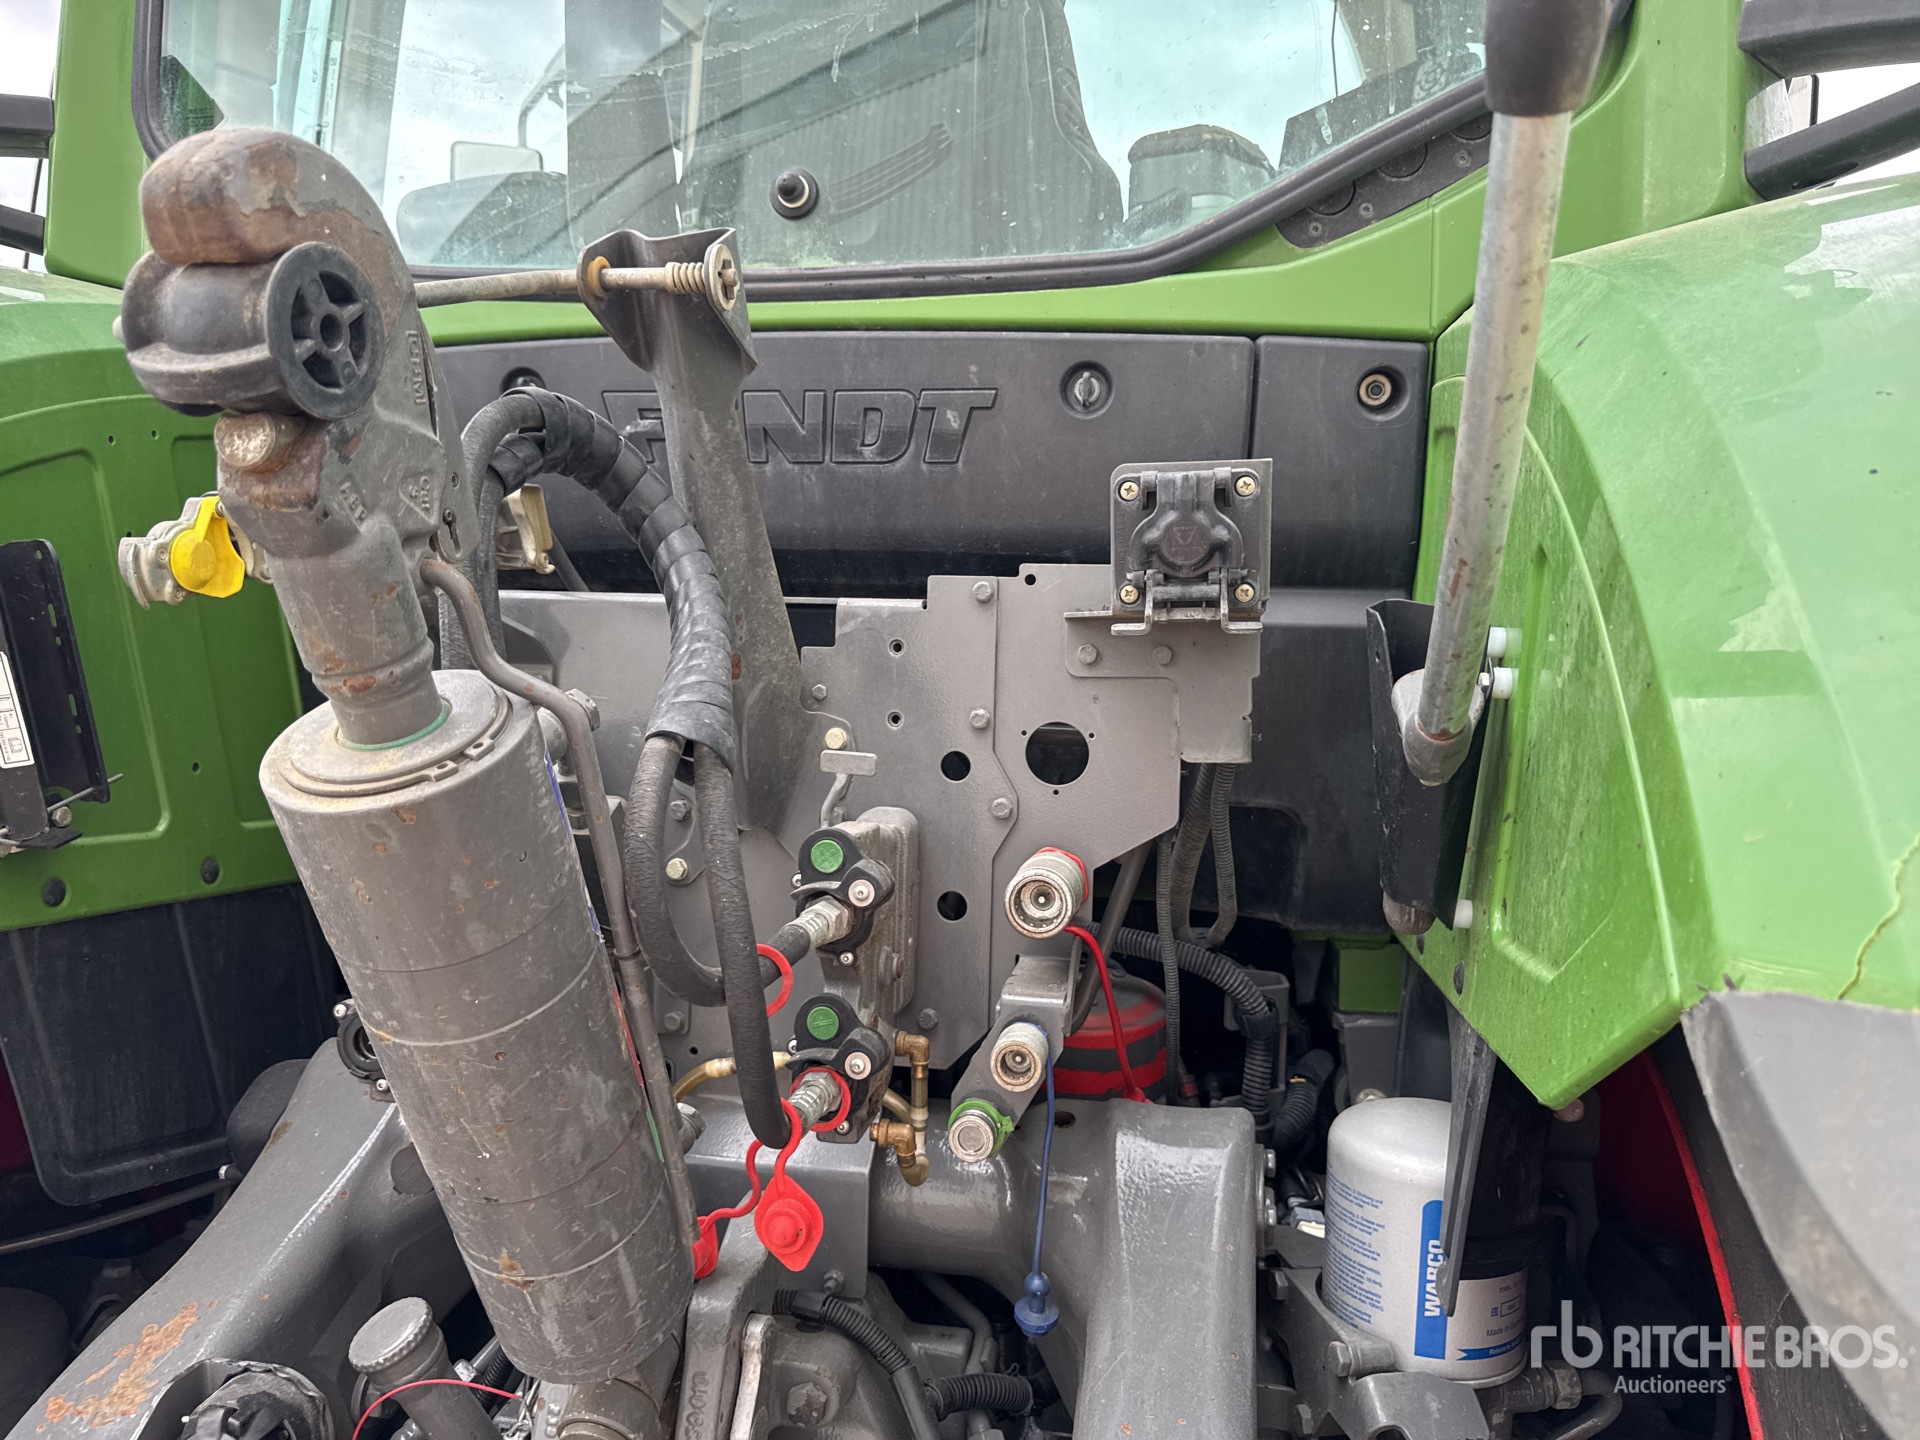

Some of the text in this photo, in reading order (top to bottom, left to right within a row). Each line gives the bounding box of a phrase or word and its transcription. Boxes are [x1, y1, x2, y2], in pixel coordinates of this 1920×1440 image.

[602, 388, 999, 464] FNDT
[1424, 1240, 1444, 1316] WABCO
[1486, 1328, 1504, 1337] Made
